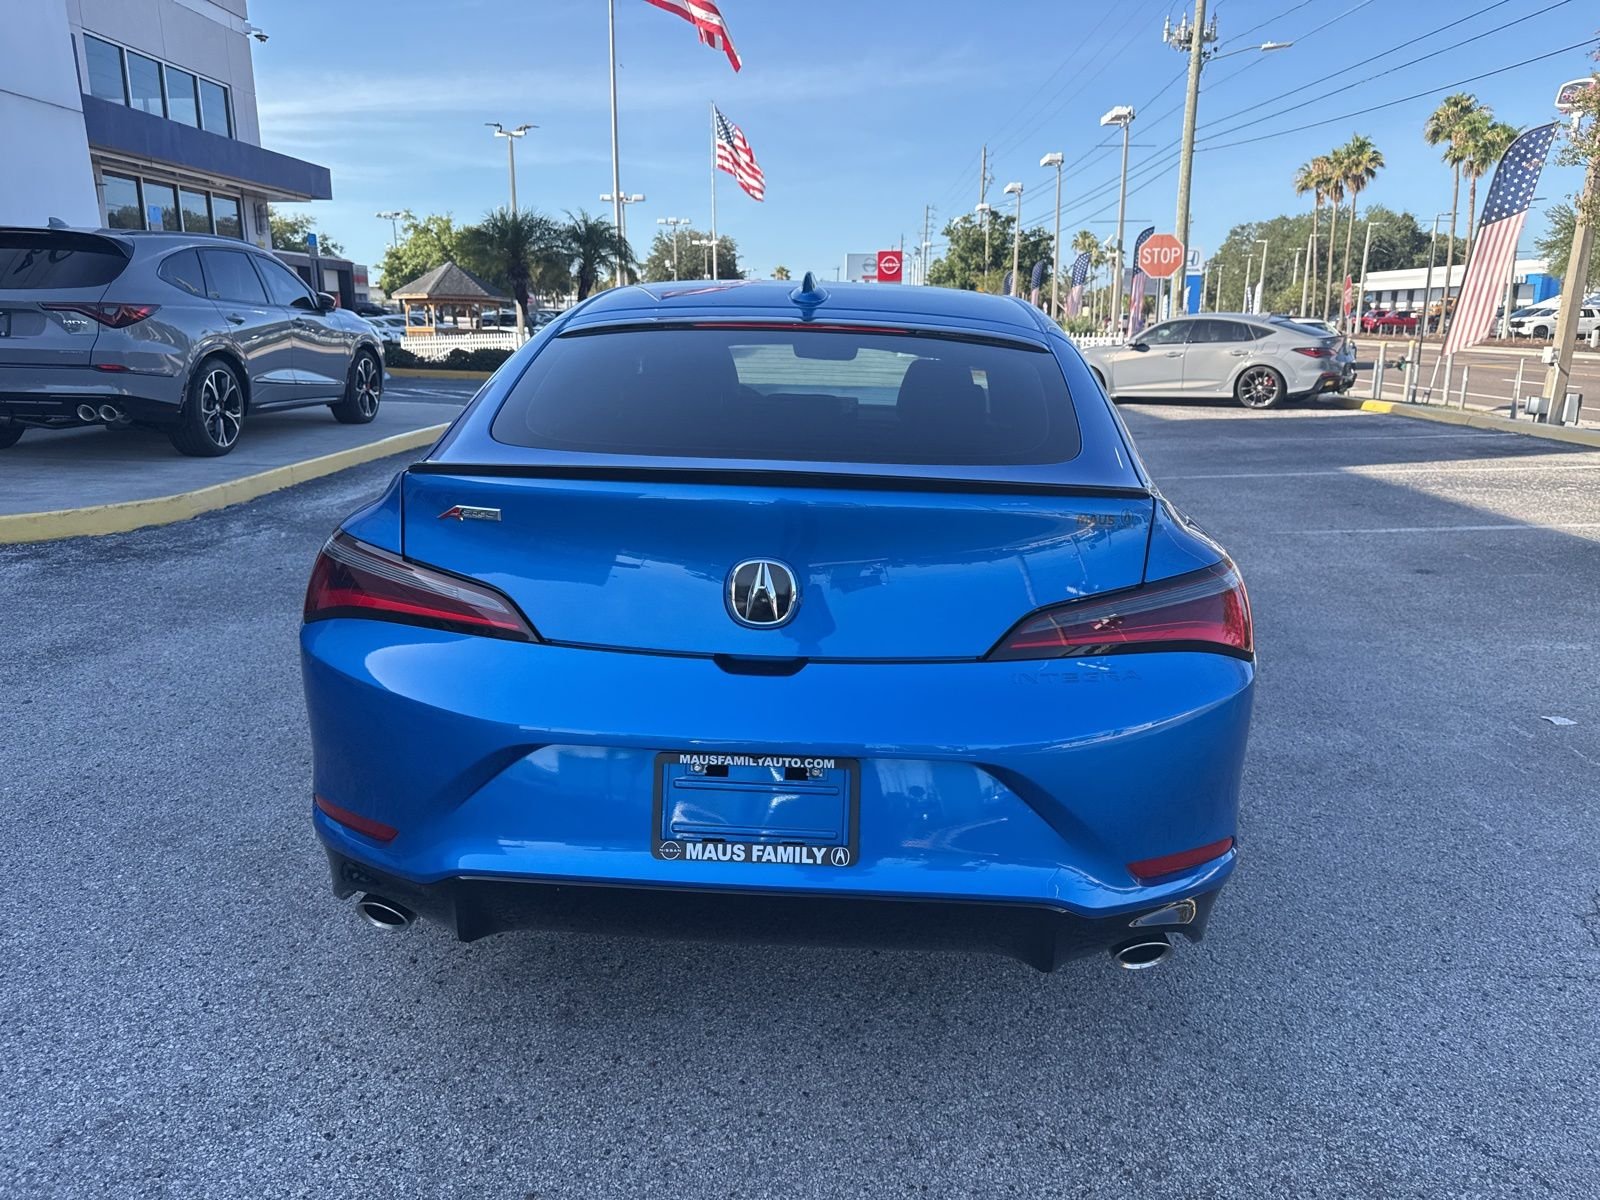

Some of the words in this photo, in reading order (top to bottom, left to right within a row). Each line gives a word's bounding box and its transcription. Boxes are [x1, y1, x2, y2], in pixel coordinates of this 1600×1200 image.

[1142, 247, 1180, 264] STOP
[1077, 514, 1115, 525] MAUS
[1008, 670, 1143, 685] INTEGRA
[679, 754, 835, 769] MAUSFAMILYAUTO.COM
[685, 842, 746, 862] MAUS
[751, 845, 827, 865] FAMILY
